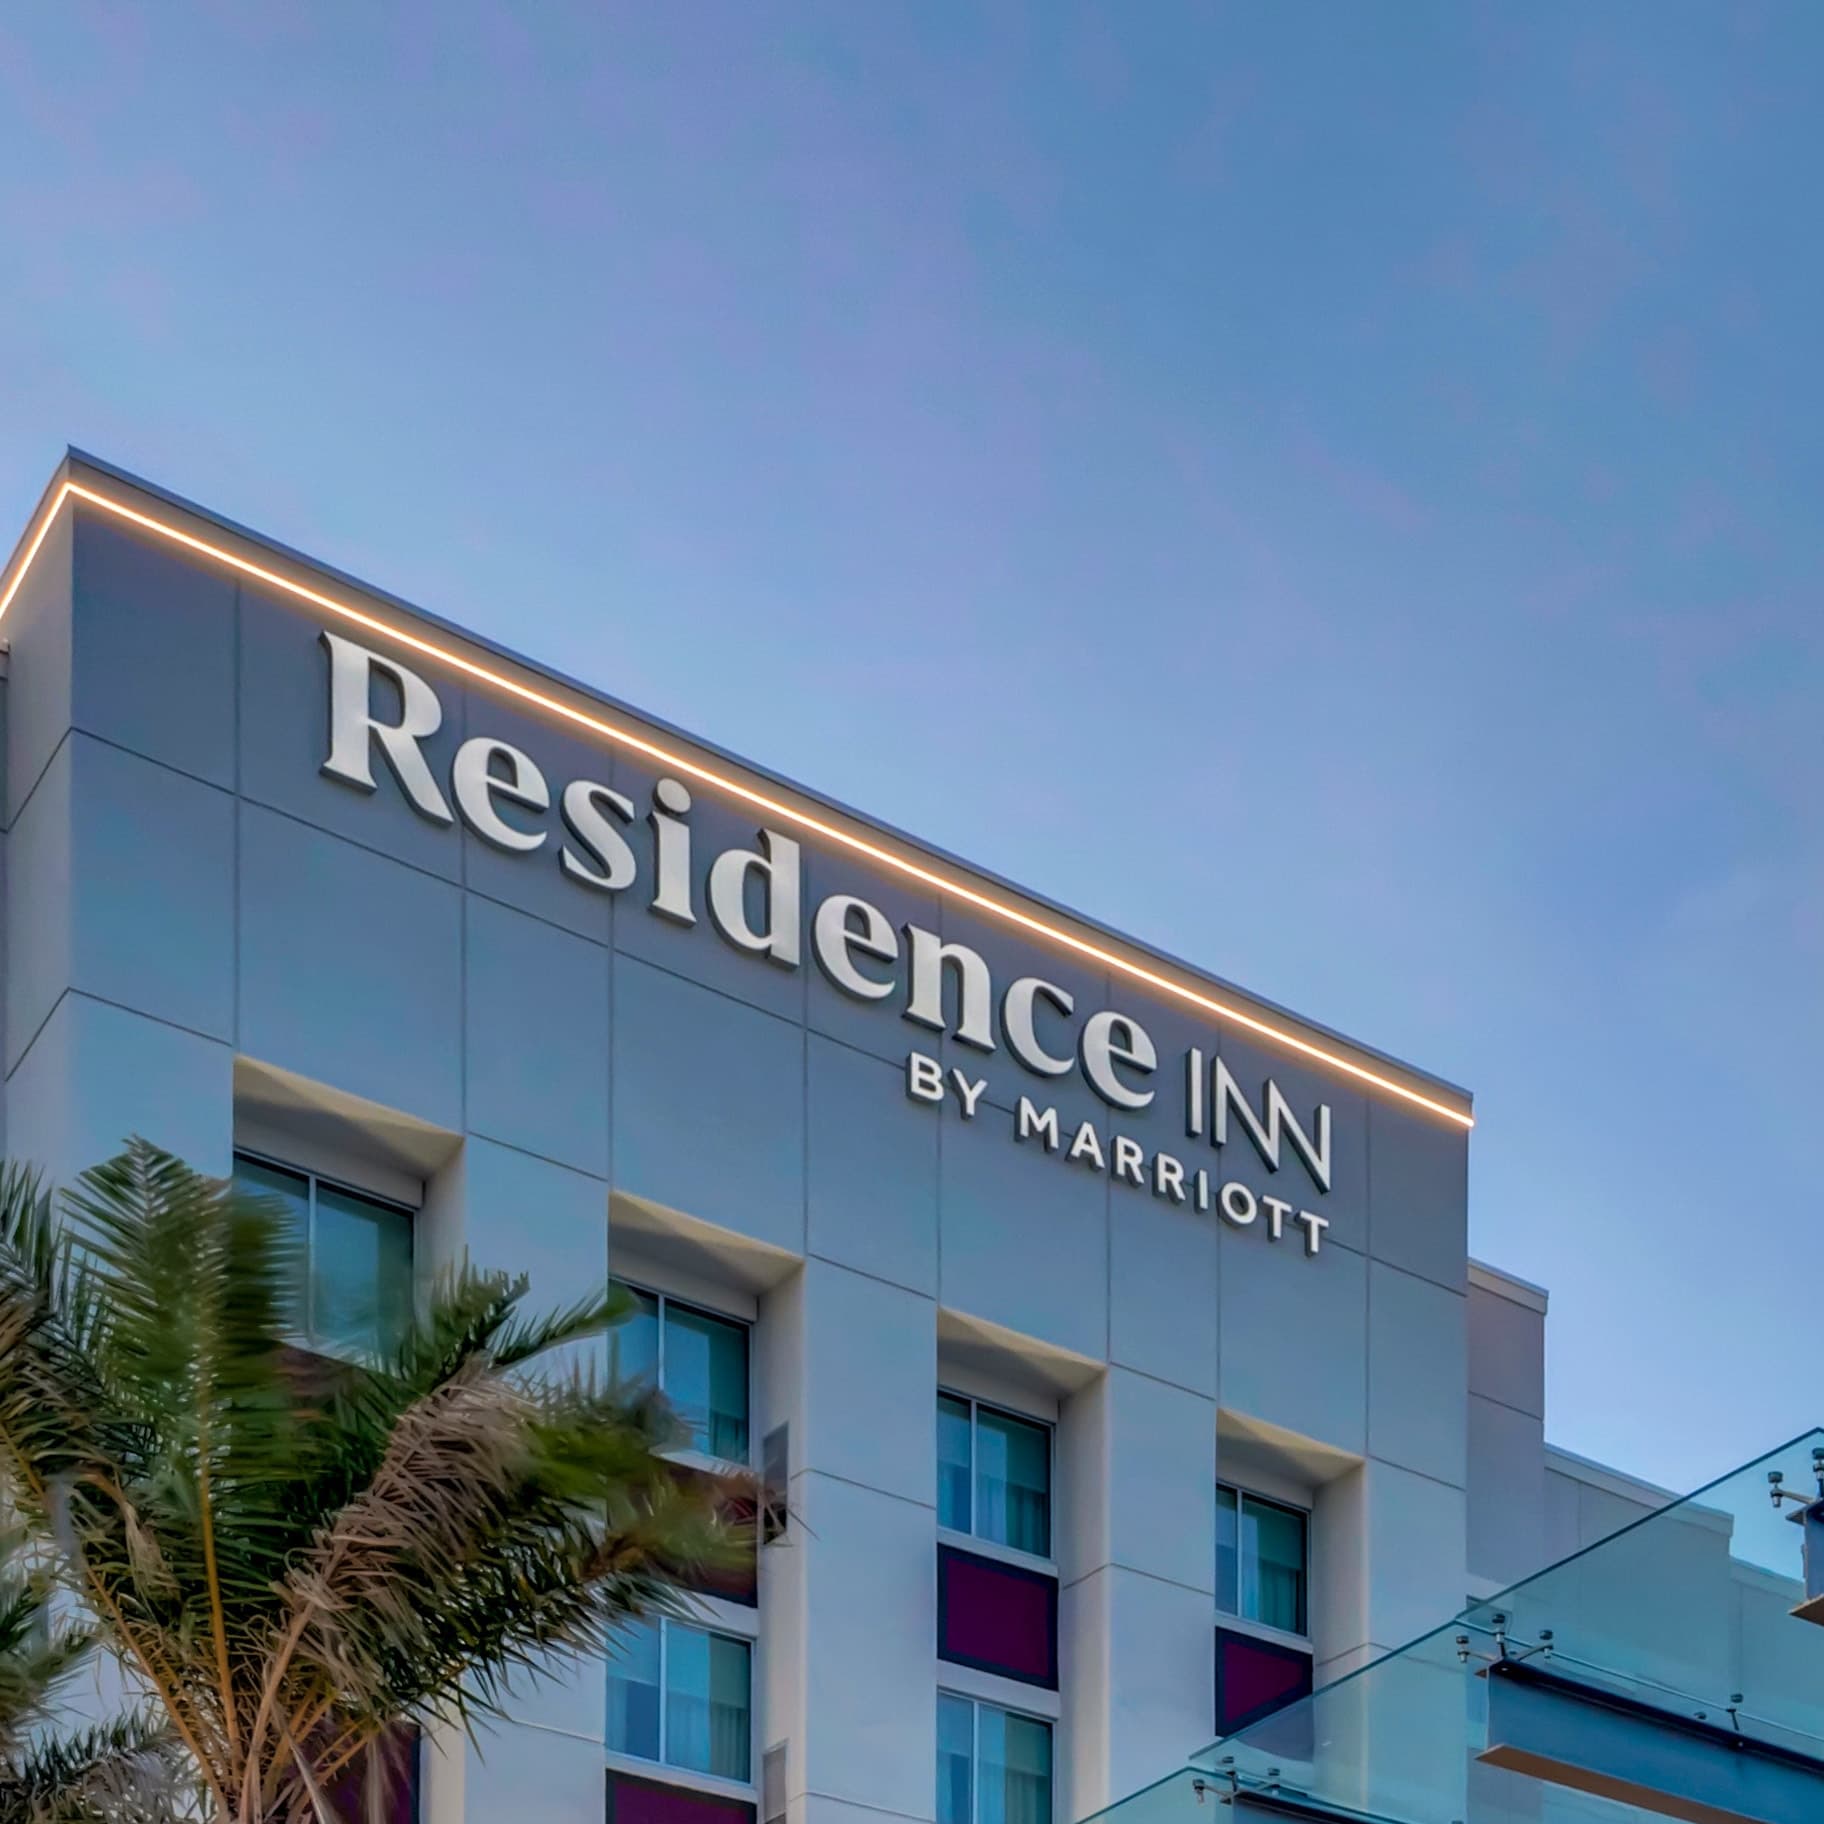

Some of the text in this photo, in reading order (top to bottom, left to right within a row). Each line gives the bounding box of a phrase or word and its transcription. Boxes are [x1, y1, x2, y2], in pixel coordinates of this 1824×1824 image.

[318, 630, 1334, 1193] Residence INN
[905, 1050, 1331, 1255] BY MARRIOTT
